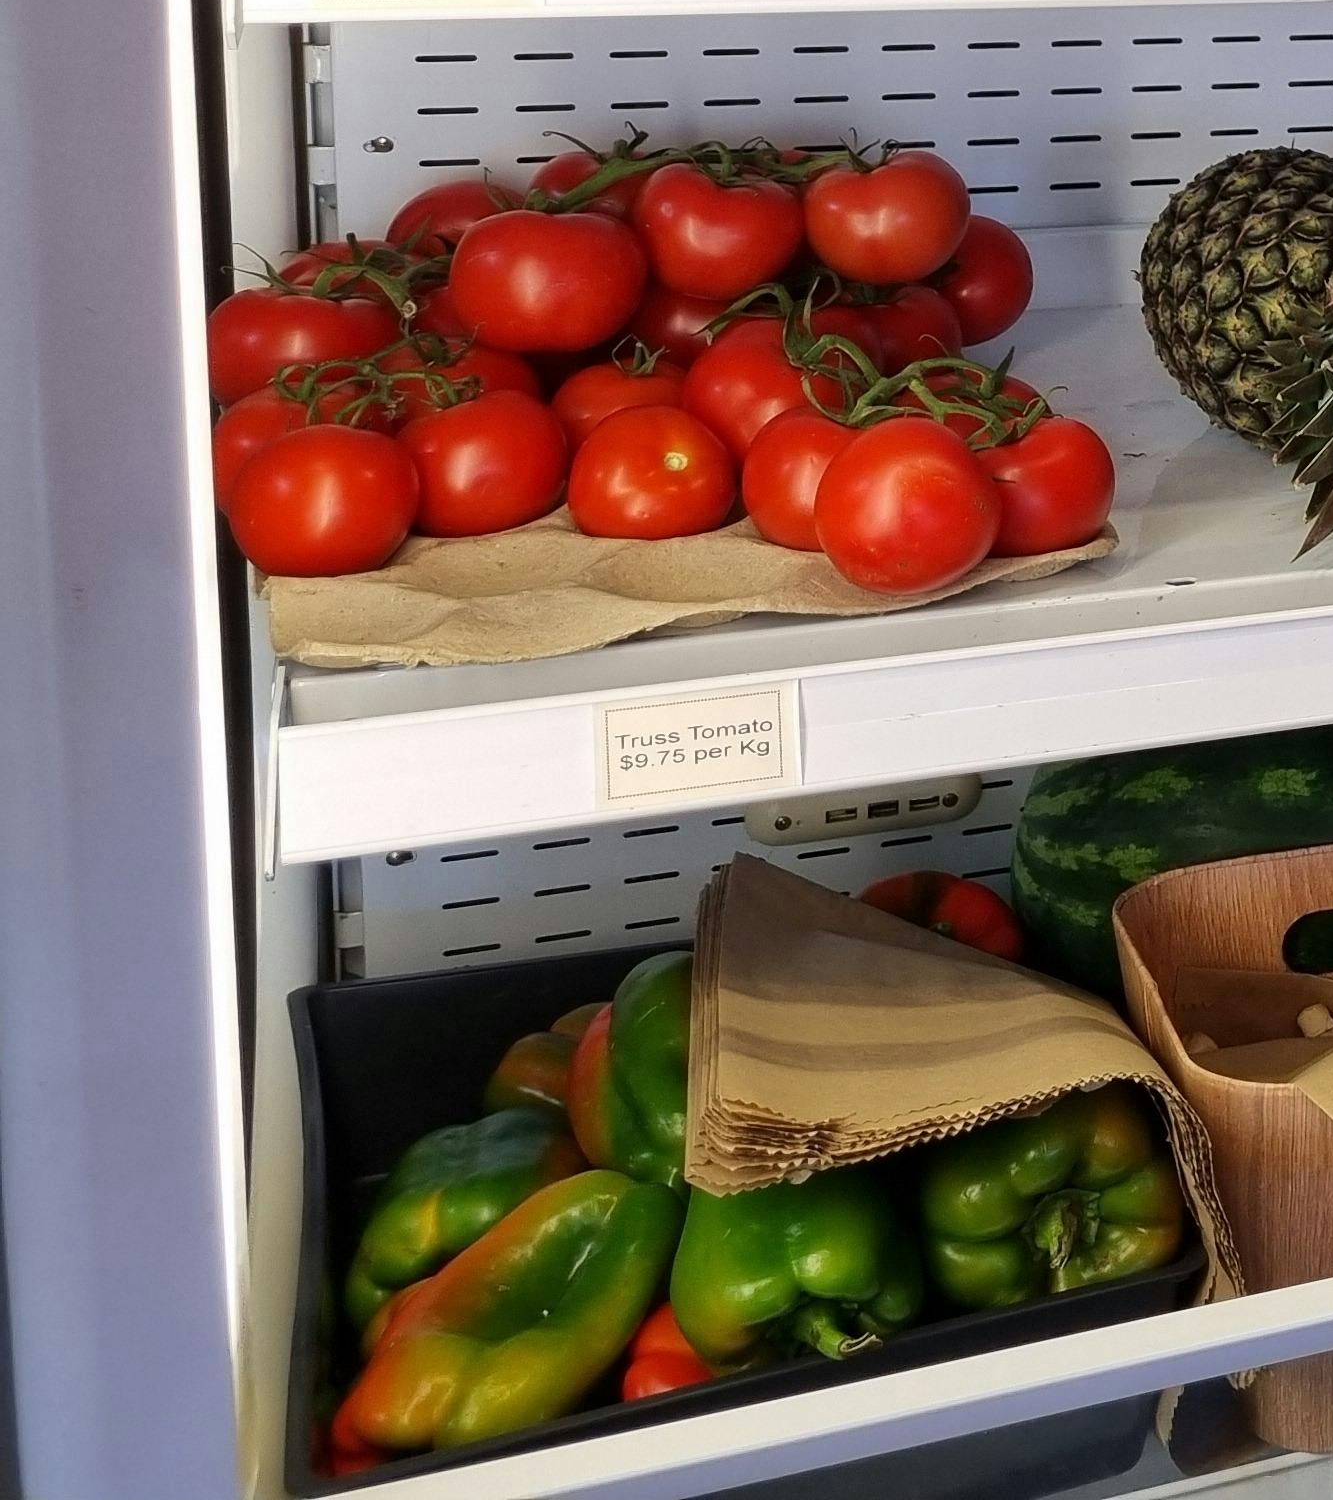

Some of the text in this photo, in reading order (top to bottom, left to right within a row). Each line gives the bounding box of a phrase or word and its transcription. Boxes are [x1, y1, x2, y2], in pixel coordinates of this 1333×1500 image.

[615, 718, 773, 750] Truss Tomato
[620, 739, 770, 772] $9.75 per Kg
